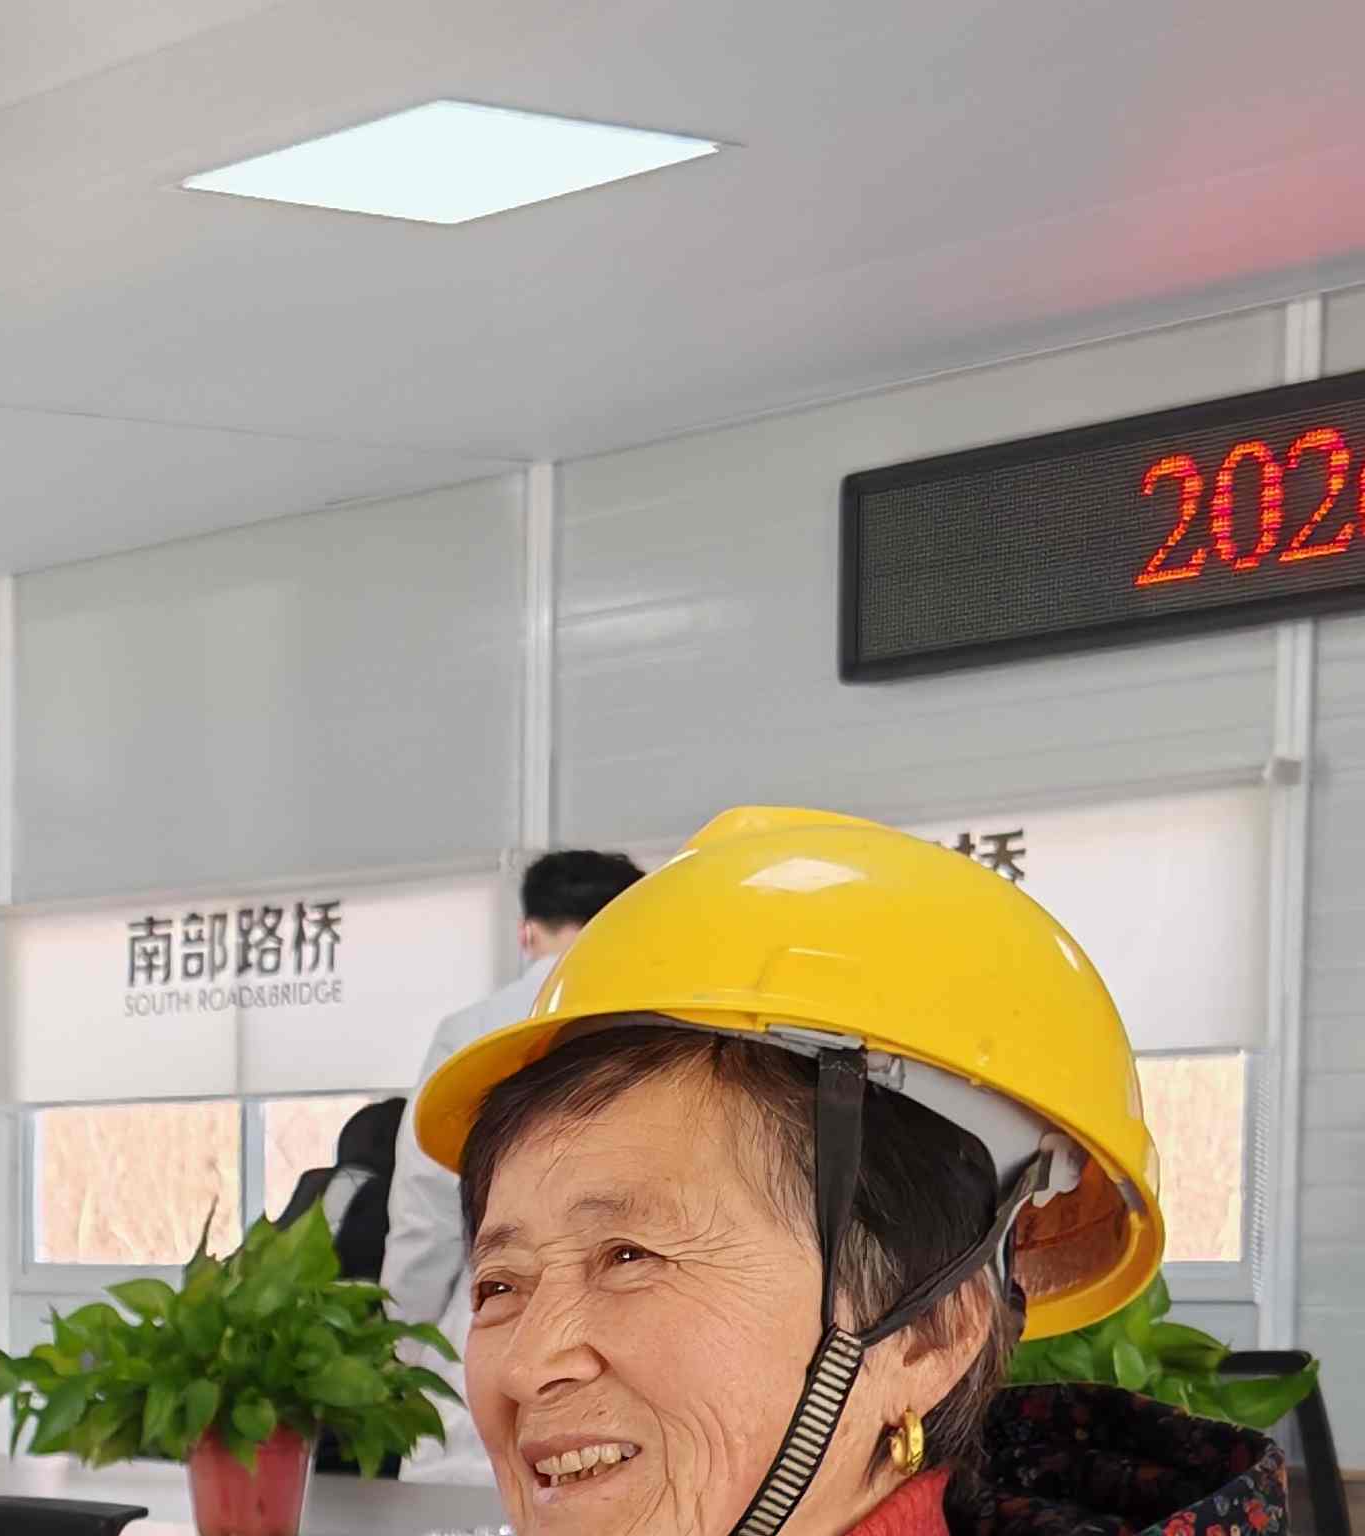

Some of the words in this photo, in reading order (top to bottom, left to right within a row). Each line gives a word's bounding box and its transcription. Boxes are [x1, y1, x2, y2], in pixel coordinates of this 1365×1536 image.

[1135, 427, 1365, 585] 202
[126, 900, 343, 988] 南部路桥
[124, 989, 191, 1017] SOUTH
[197, 979, 342, 1012] ROAD&BRIDGE
